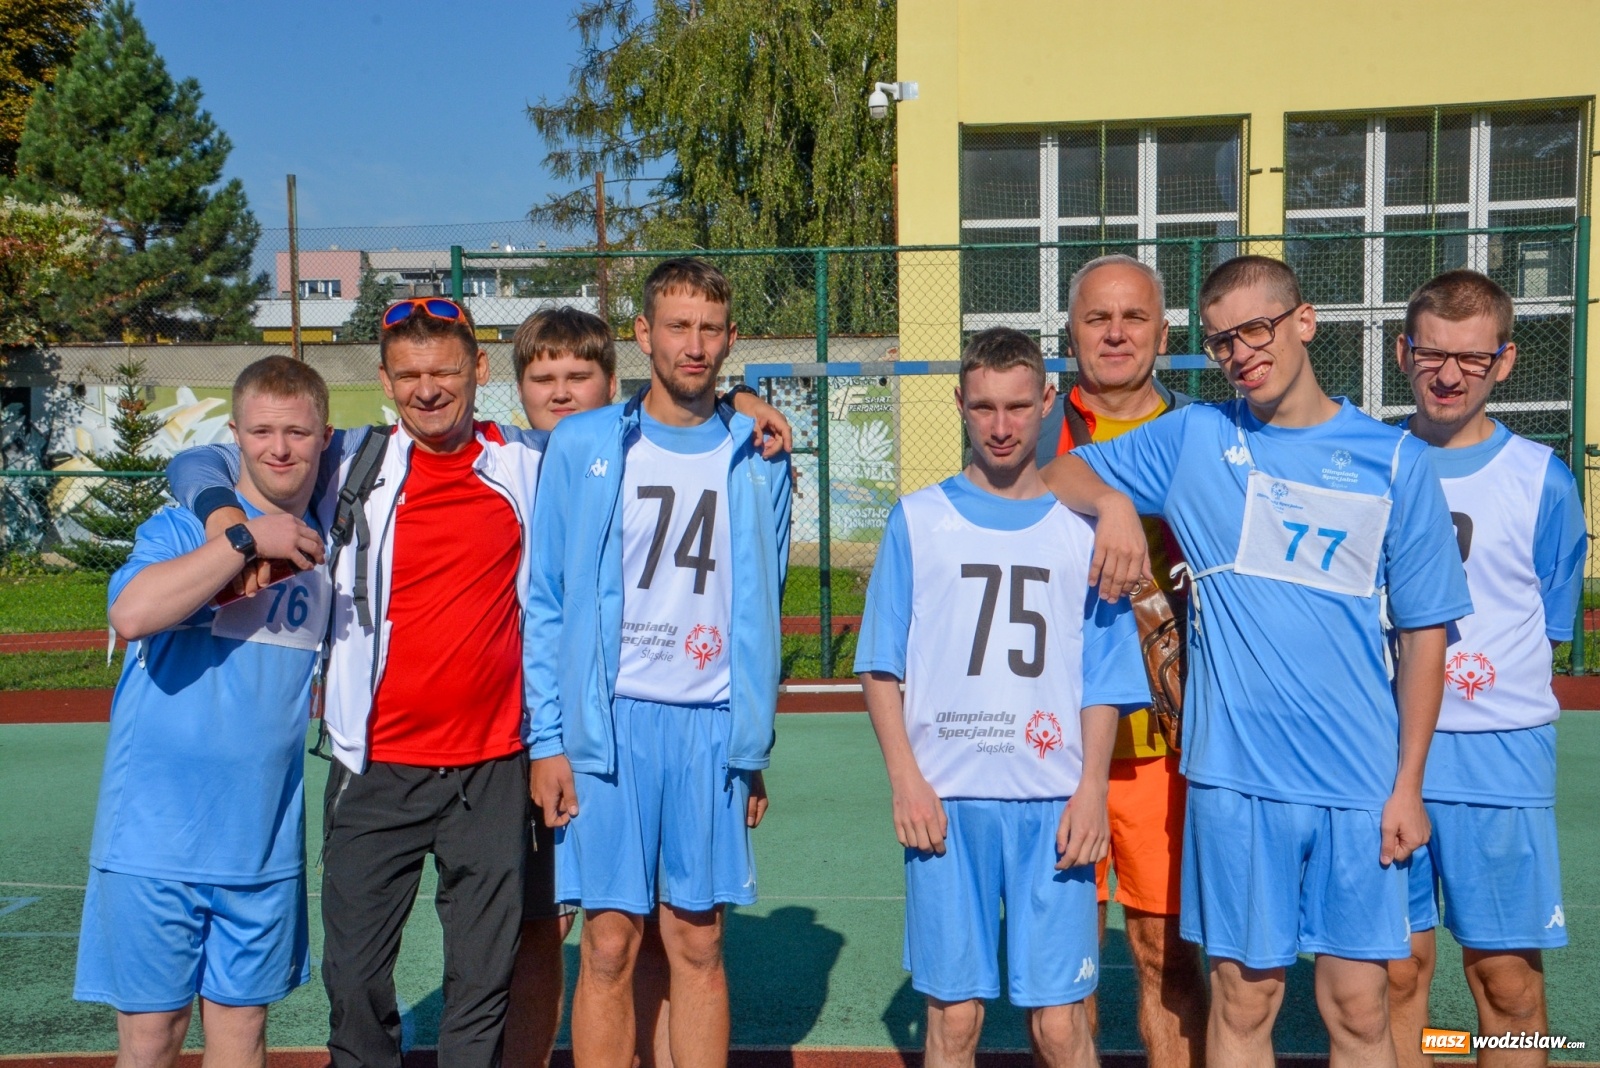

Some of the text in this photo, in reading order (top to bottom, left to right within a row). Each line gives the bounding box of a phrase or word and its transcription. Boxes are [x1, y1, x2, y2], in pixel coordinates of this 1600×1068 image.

[1322, 468, 1359, 479] Olimpiady
[637, 485, 718, 595] 74
[1282, 519, 1348, 572] 77
[265, 583, 309, 627] 76
[960, 563, 1051, 679] 75
[640, 647, 674, 662] Śląskie
[936, 710, 1017, 725] Olimpiady
[937, 726, 1016, 740] Specjalne
[976, 740, 1015, 755] Śląskie
